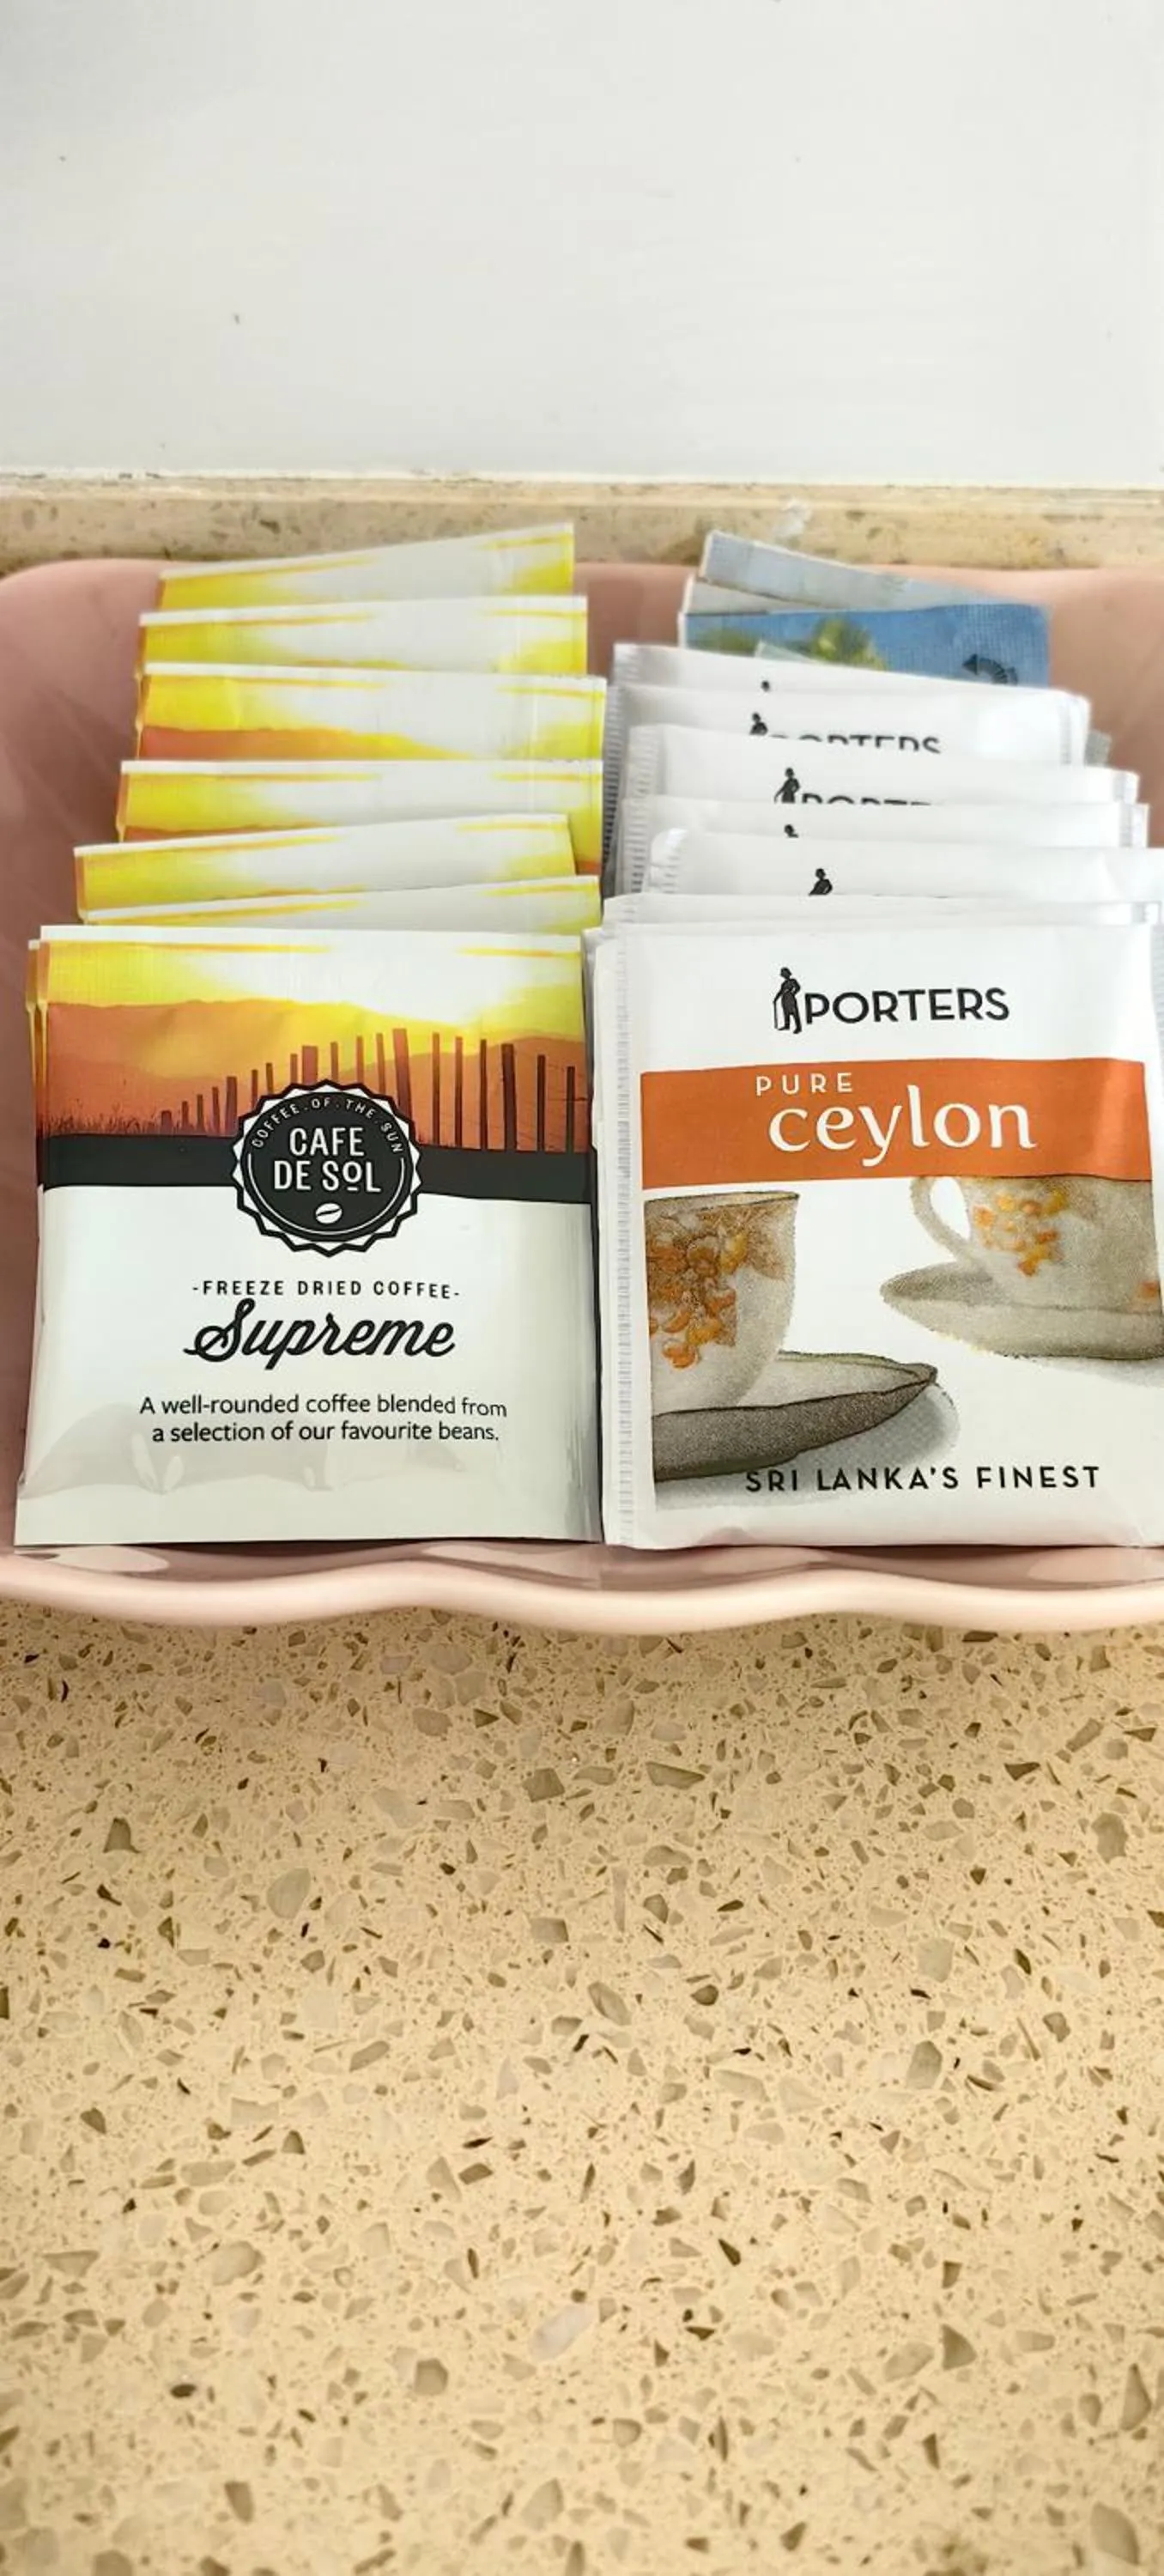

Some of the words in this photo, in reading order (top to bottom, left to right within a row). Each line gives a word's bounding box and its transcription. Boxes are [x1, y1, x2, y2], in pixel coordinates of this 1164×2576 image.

[804, 987, 1009, 1024] PORTERS
[756, 1072, 853, 1096] PURE
[252, 1103, 300, 1149] COFFEE
[311, 1097, 331, 1109] OF
[345, 1098, 376, 1119] THE
[380, 1121, 404, 1153] SUN
[768, 1084, 1037, 1167] ceylon
[288, 1127, 365, 1157] CAFE
[274, 1160, 312, 1190] DE
[297, 1280, 362, 1297] DRIED
[183, 1297, 456, 1370] Supreme
[139, 1396, 155, 1414] A
[161, 1394, 300, 1415] well-rounded
[306, 1394, 371, 1413] coffee
[377, 1394, 457, 1414] blended
[461, 1396, 508, 1418] from
[152, 1427, 165, 1443] a
[170, 1422, 266, 1443] selection
[270, 1420, 294, 1441] of
[298, 1425, 336, 1440] our
[340, 1420, 432, 1440] favourite
[438, 1421, 500, 1442] beans.
[745, 1469, 798, 1492] SRI
[977, 1465, 1100, 1489] FINEST
